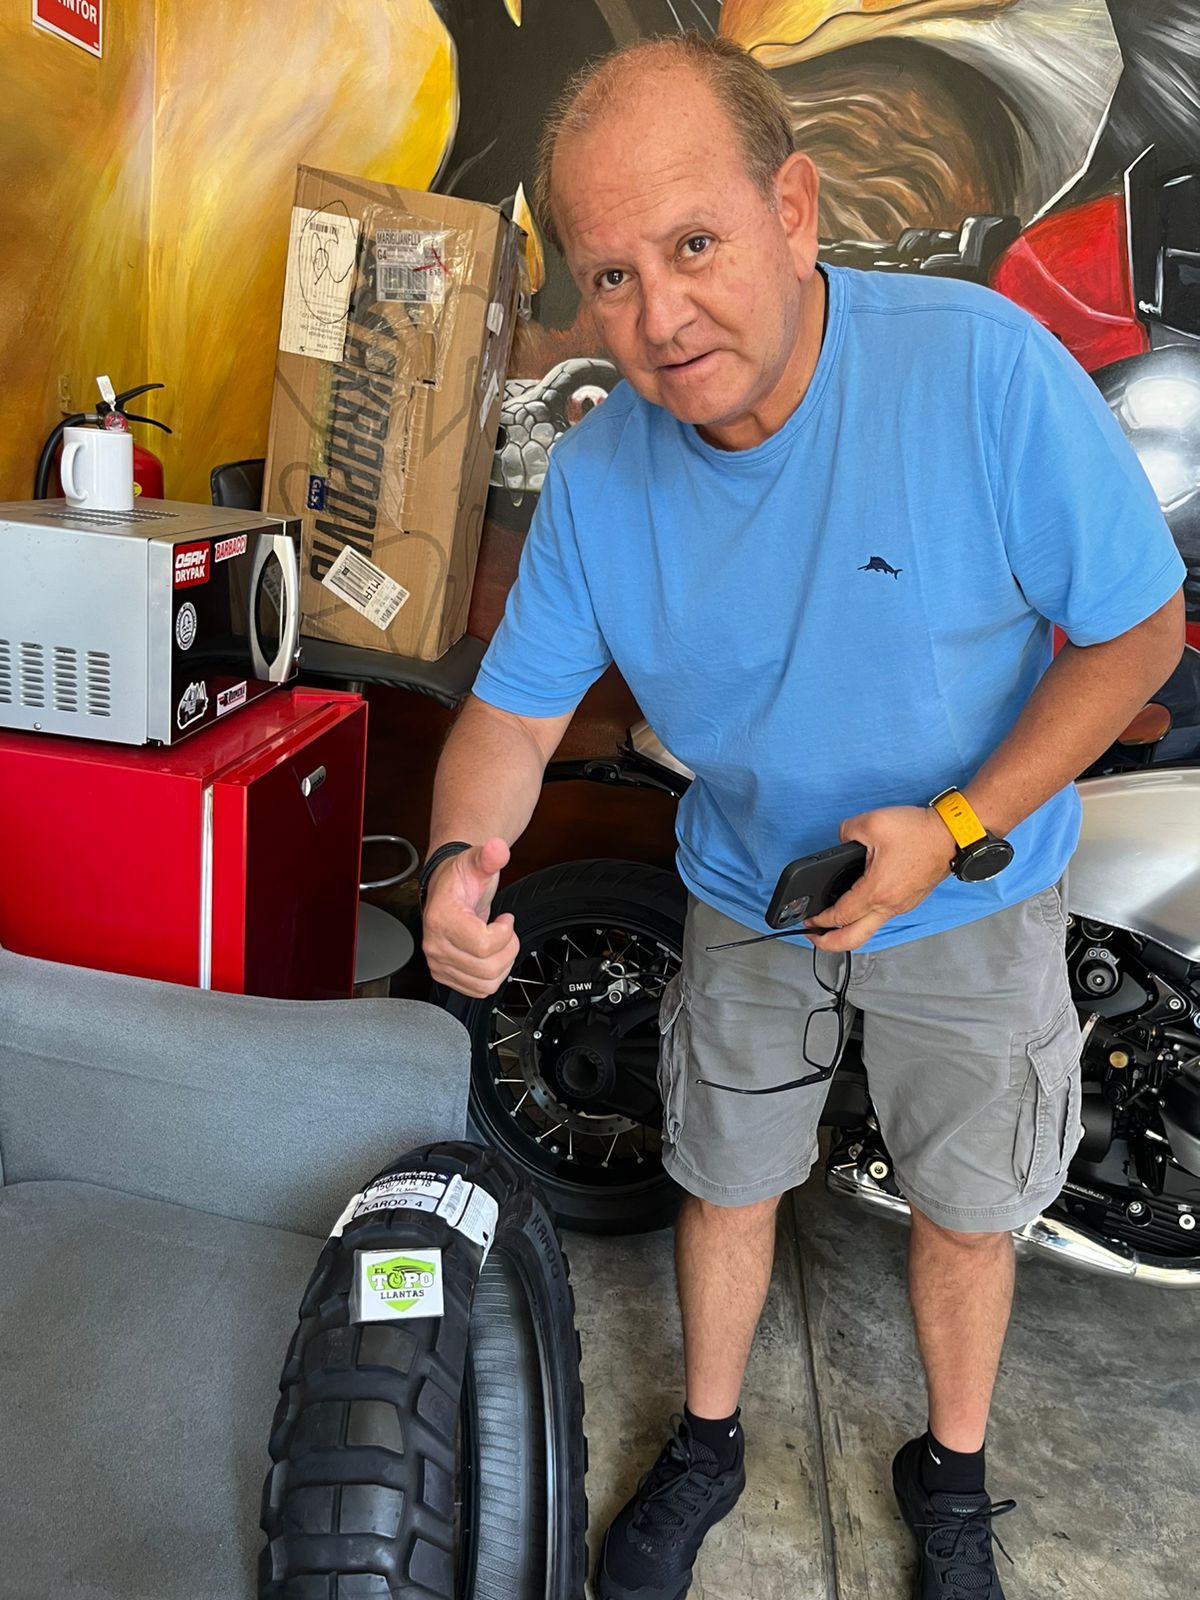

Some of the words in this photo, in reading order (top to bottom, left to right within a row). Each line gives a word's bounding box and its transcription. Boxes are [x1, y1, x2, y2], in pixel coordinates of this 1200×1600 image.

[175, 565, 205, 583] DRYPAK
[361, 579, 381, 601] MIA
[569, 982, 592, 992] BMW
[363, 1199, 408, 1212] KAROO
[531, 1213, 560, 1279] KAROO
[371, 1271, 435, 1291] TOPO
[380, 1289, 425, 1300] LLANTAS
